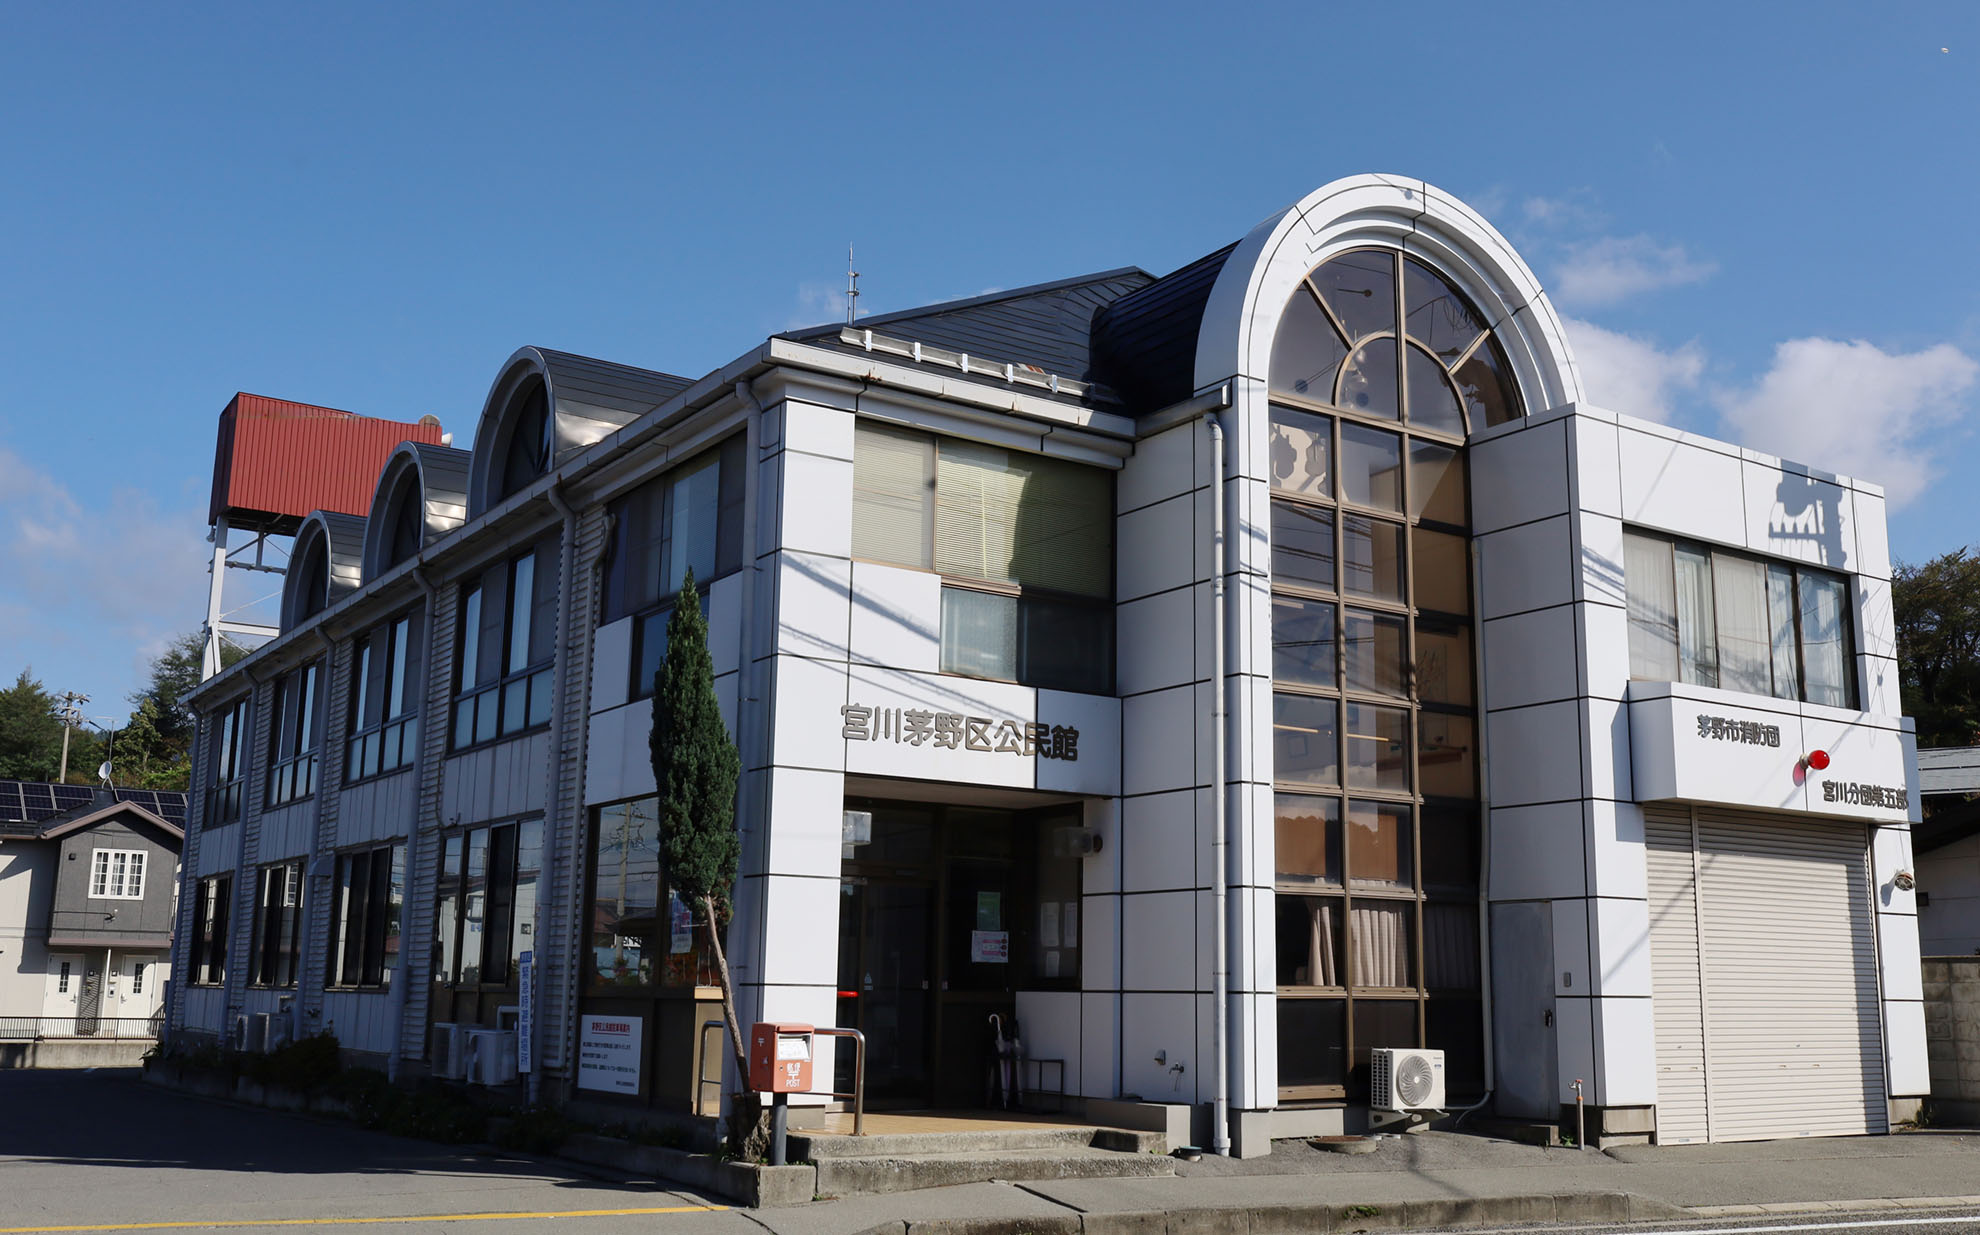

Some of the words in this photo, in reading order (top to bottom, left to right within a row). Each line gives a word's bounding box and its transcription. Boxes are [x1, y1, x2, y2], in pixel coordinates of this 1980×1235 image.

[840, 702, 1080, 762] 宮川茅野区公民館
[1696, 713, 1781, 748] 茅野市消防団
[1821, 779, 1909, 811] 宮川分団第五部
[785, 1079, 801, 1088] POST
